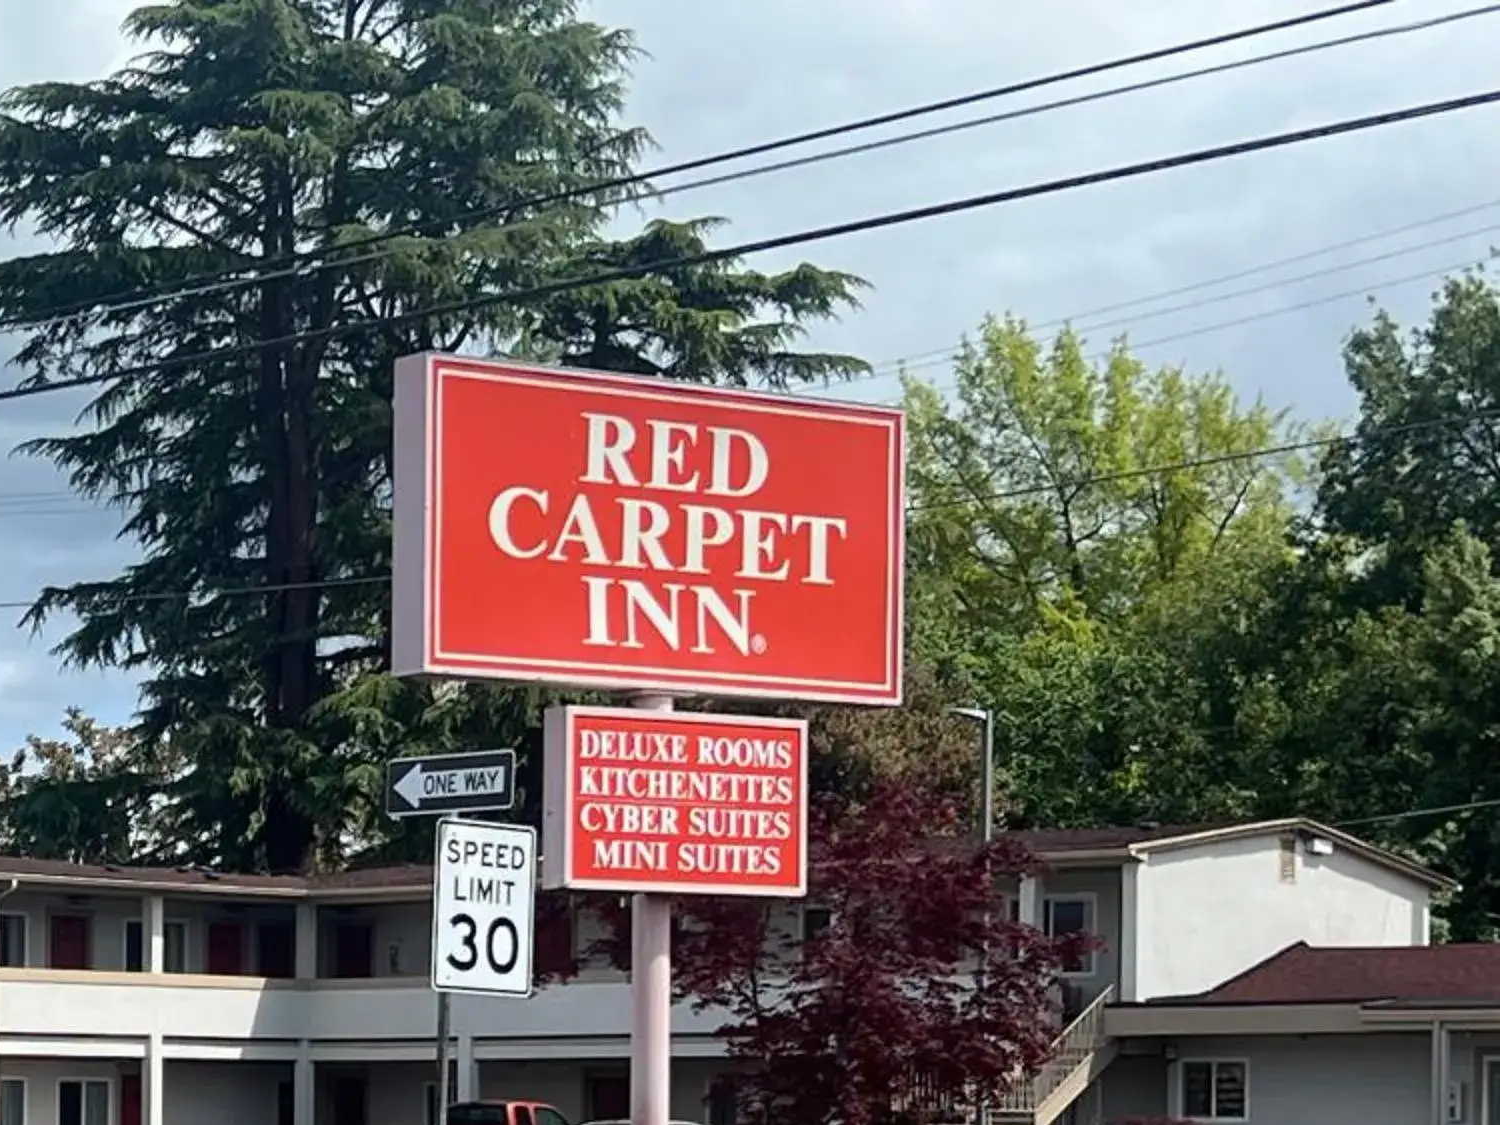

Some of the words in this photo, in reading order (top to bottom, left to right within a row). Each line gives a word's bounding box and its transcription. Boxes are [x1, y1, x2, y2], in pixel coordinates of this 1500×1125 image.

[579, 412, 770, 497] RED
[488, 486, 847, 585] CARPET
[581, 575, 757, 656] INN
[579, 729, 688, 763] DELUXE
[697, 736, 792, 769] ROOMS
[423, 773, 458, 795] ONE
[463, 769, 499, 792] WAY
[579, 765, 793, 804] KITCHENETTES
[579, 802, 679, 834] CYBER
[688, 806, 791, 840] SUITES
[446, 838, 525, 871] SPEED
[592, 839, 669, 871] MINI
[677, 842, 781, 875] SUITES
[453, 876, 516, 905] LIMIT
[446, 912, 519, 975] 30
